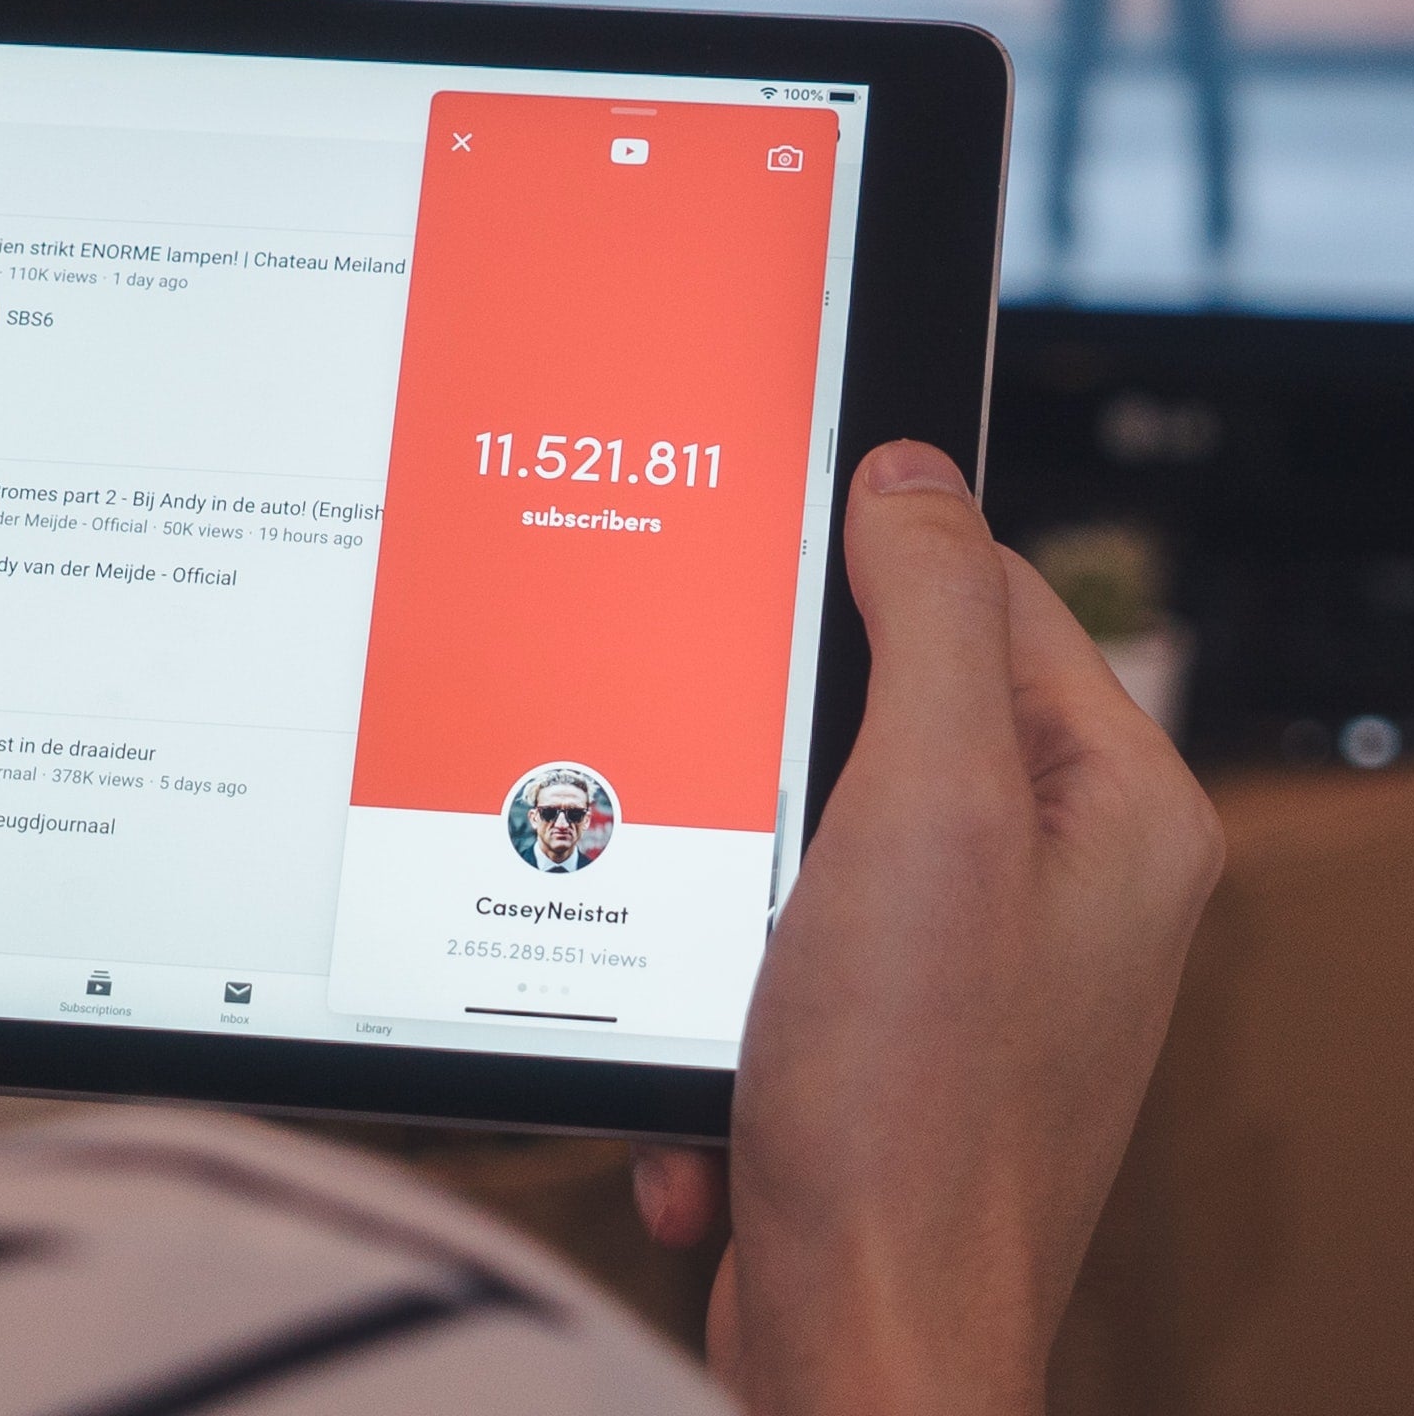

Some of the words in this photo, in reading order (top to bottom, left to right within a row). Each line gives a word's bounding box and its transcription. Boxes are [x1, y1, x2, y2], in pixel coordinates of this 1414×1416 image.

[784, 89, 823, 101] 100%
[30, 242, 74, 257] strikt
[81, 243, 161, 261] ENORME
[167, 247, 238, 267] lampen!
[255, 252, 328, 270] Chateau
[334, 256, 405, 274] Meiland
[11, 267, 48, 281] 110K
[54, 269, 97, 284] views
[114, 272, 119, 285] 1
[127, 273, 154, 290] day
[159, 278, 188, 291] ago
[7, 310, 53, 327] SBS6
[476, 432, 720, 488] 11.521.811
[63, 491, 99, 506] part
[106, 490, 116, 505] 2
[133, 491, 154, 511] Bij
[160, 493, 206, 514] Andy
[212, 500, 226, 511] in
[233, 497, 255, 513] de
[261, 501, 306, 515] auto!
[313, 500, 385, 524] (English
[522, 506, 661, 532] subscribers
[25, 513, 77, 532] Meijde
[92, 517, 147, 533] Official
[163, 521, 193, 536] 50K
[199, 527, 243, 539] views
[261, 528, 277, 540] 19
[283, 528, 328, 544] hours
[334, 535, 362, 549] ago
[24, 562, 54, 574] van
[61, 560, 90, 576] der
[96, 563, 155, 584] Meijde
[173, 567, 236, 585] Official
[20, 737, 35, 753] in
[42, 739, 63, 755] de
[70, 740, 156, 760] draaideur
[52, 769, 93, 784] 378K
[99, 775, 143, 788] views
[160, 776, 169, 789] 5
[175, 776, 211, 795] days
[217, 783, 247, 797] ago
[476, 897, 628, 924] CaseyNeistat
[447, 939, 583, 963] 2.655.289.551
[591, 949, 646, 968] views
[60, 1002, 131, 1016] Subscriptions
[220, 1014, 249, 1024] Inbox
[356, 1023, 392, 1036] Library
